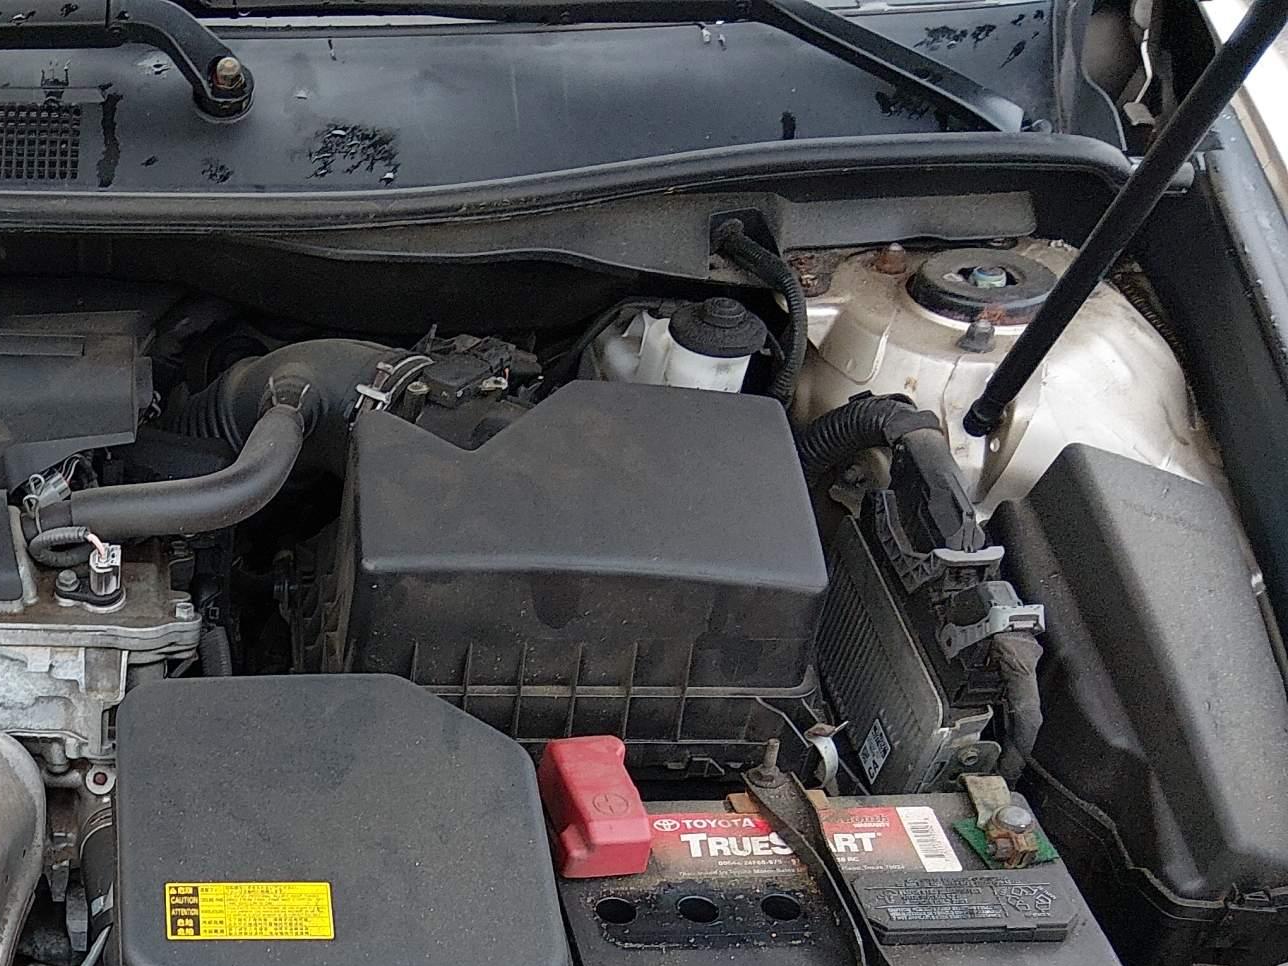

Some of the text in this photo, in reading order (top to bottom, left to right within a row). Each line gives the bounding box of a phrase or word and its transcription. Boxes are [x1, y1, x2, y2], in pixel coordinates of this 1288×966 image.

[682, 817, 755, 830] TOYOTA
[171, 896, 199, 904] CAUTION
[171, 908, 199, 916] ATTENTION
